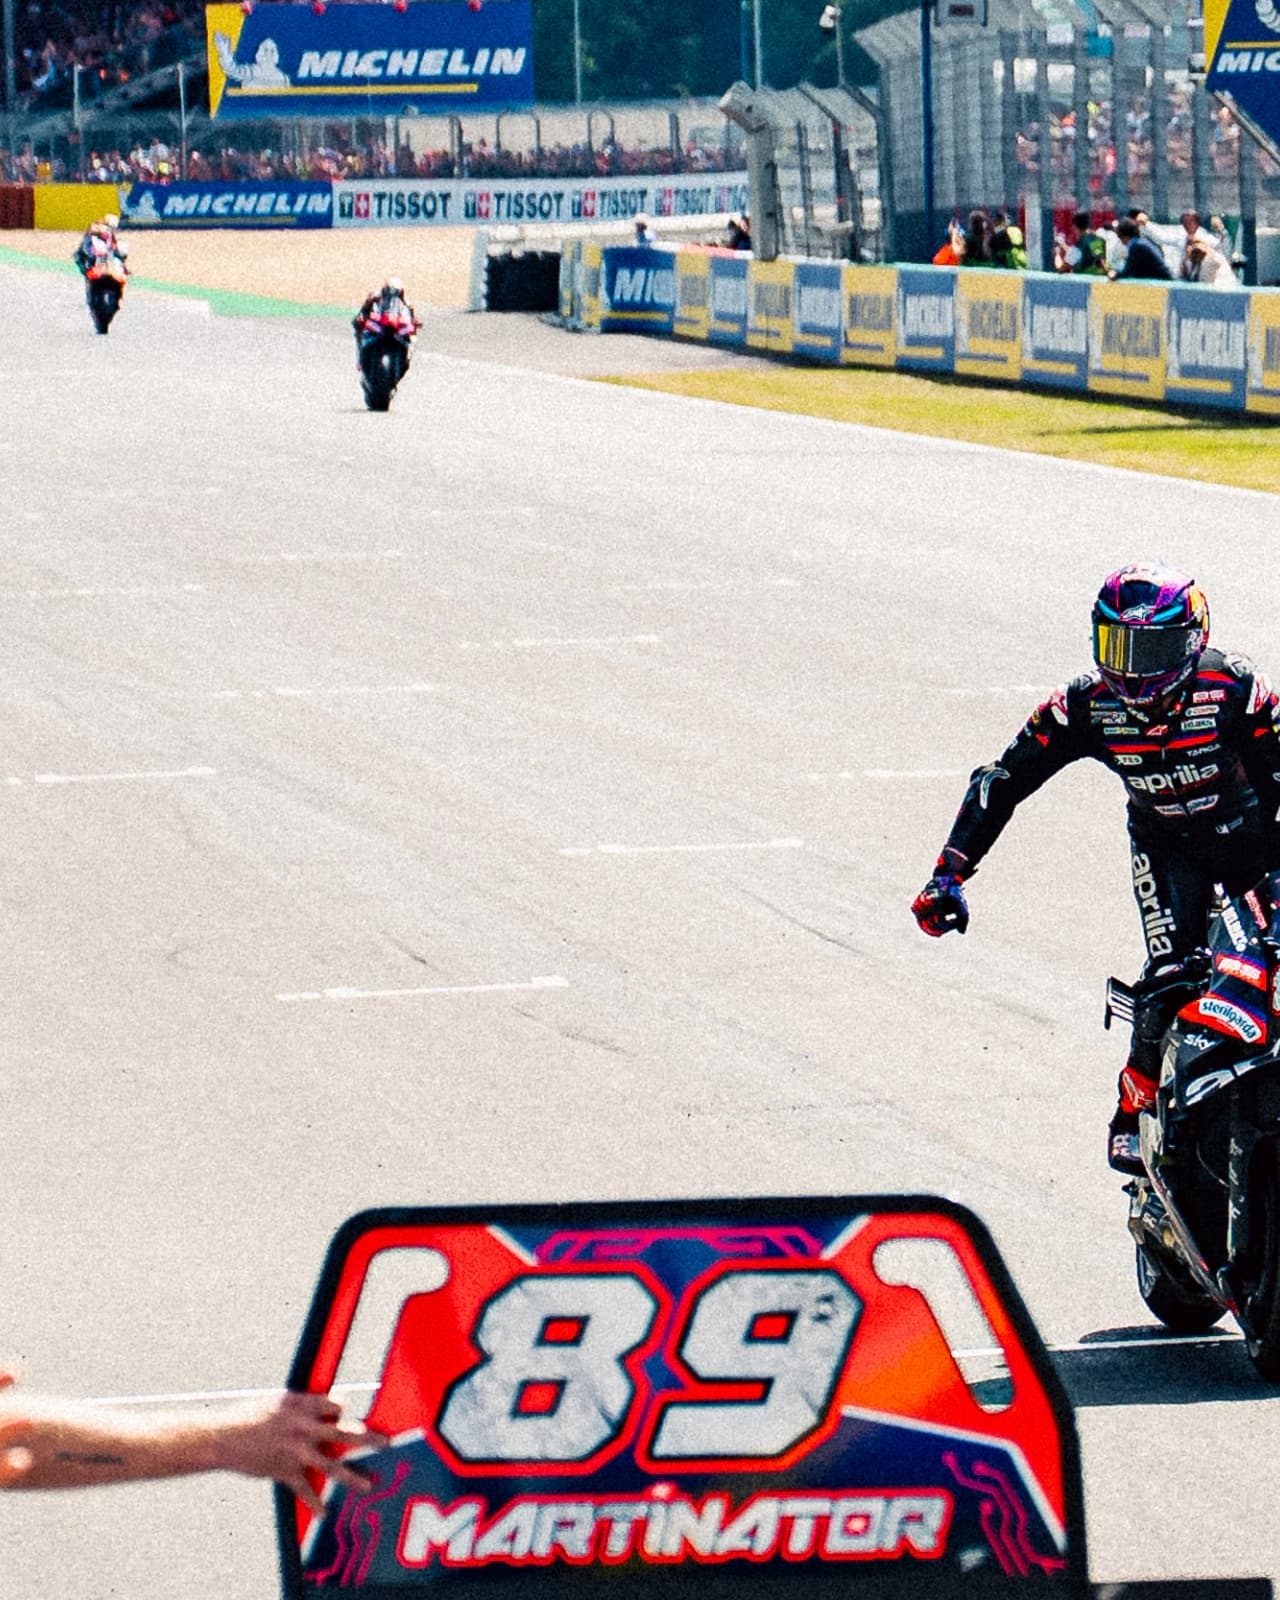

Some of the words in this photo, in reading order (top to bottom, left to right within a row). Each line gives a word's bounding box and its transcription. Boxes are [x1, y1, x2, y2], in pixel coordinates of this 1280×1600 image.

[298, 47, 527, 80] MICHELIN
[163, 190, 332, 216] MICHELIN
[373, 190, 452, 220] TISSOT
[493, 190, 565, 219] TISSOT
[598, 187, 648, 216] TISSOT
[1126, 763, 1220, 795] aprilia
[1131, 852, 1176, 958] aprilia
[1201, 1001, 1257, 1040] sterilgarda
[438, 1267, 865, 1462] 89
